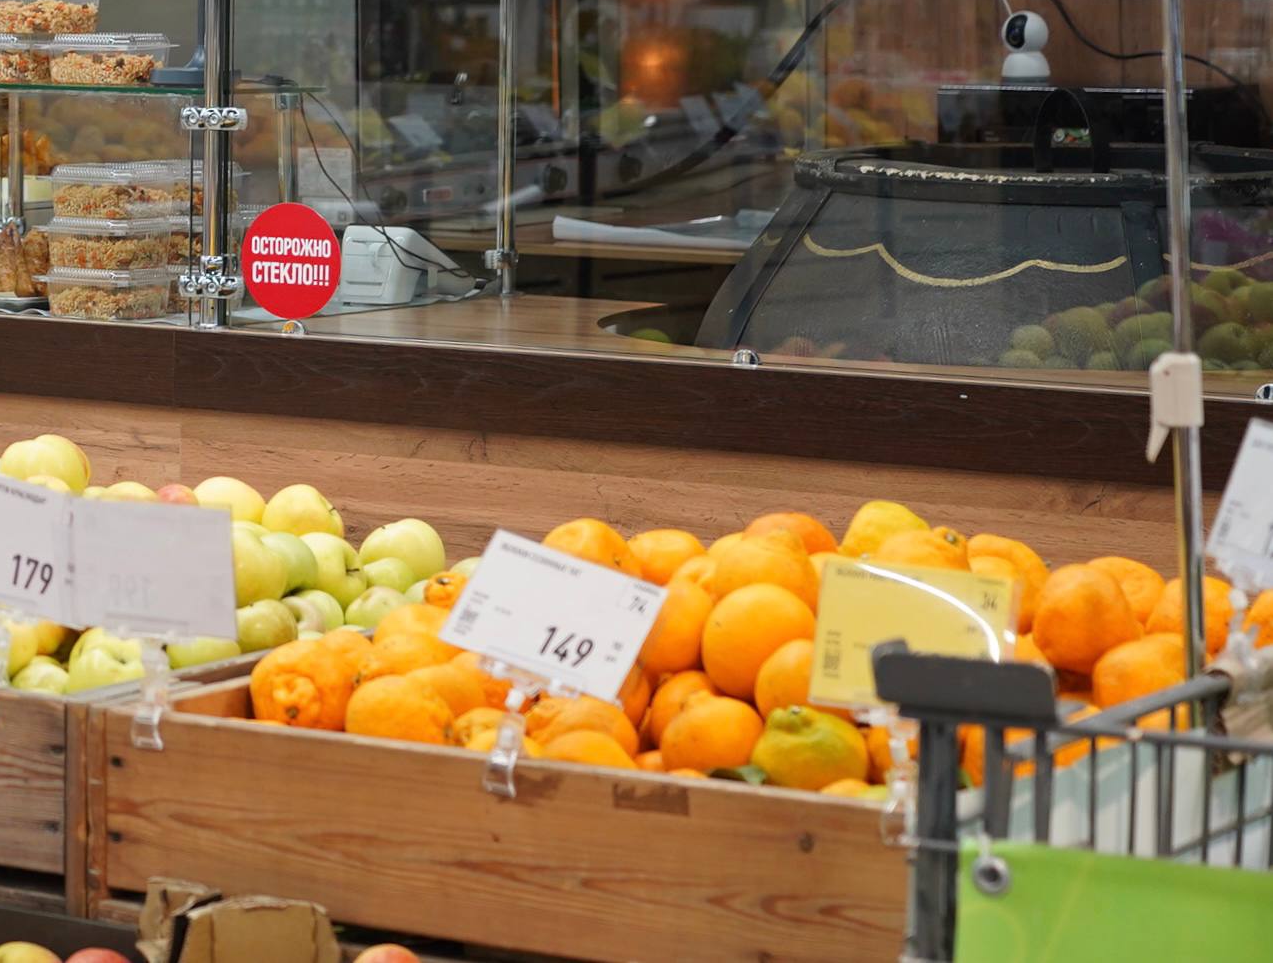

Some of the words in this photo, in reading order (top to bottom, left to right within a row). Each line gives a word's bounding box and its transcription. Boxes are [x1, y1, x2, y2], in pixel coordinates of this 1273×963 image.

[251, 235, 332, 258] ОСТОРОЖНО
[252, 261, 330, 286] СТЕКЛО!!!
[12, 554, 54, 594] 179
[539, 626, 595, 667] 149
